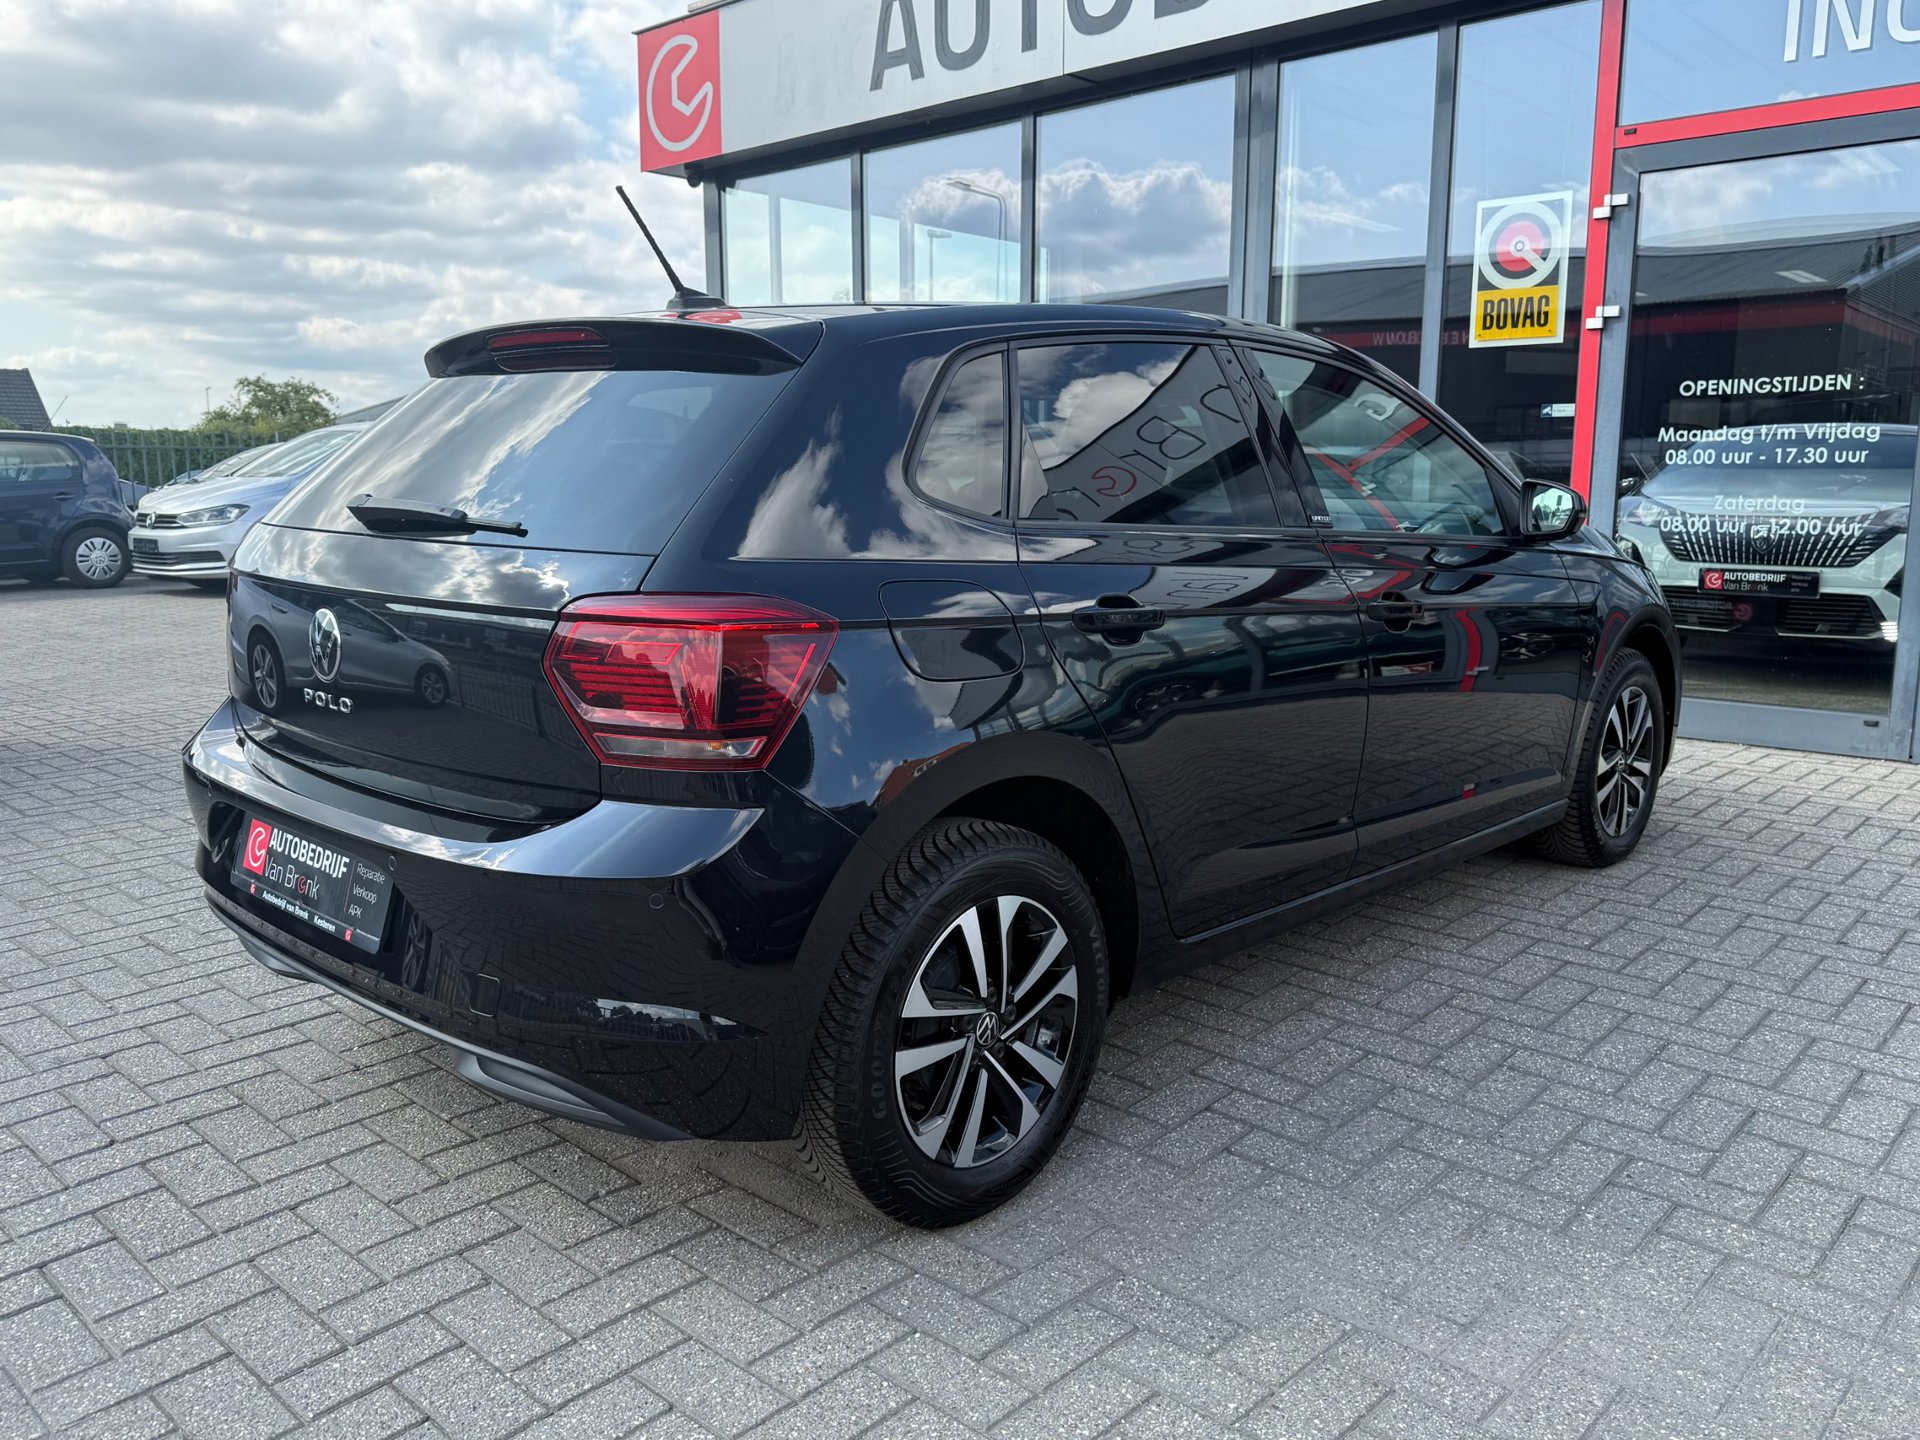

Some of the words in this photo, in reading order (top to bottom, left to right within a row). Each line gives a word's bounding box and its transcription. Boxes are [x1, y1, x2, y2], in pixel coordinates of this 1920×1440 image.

[1482, 295, 1550, 331] BOVAG
[1679, 374, 1852, 397] OPENINGSTIJDEN
[1658, 425, 1754, 445] Maandag
[1760, 425, 1796, 442] t/m
[1804, 422, 1881, 443] Vrijdag
[1665, 449, 1716, 465] 08.00
[1721, 451, 1753, 465] uur
[1774, 447, 1828, 464] 17.30
[1834, 448, 1869, 464] uur
[1713, 495, 1806, 514] Zaterdag
[1660, 516, 1710, 533] 08.00
[1716, 519, 1746, 533] uur
[1769, 517, 1822, 535] 12.00
[1826, 519, 1862, 536] uur
[1723, 571, 1787, 583] AUTOBEDRIJF
[1723, 582, 1740, 591] Van
[304, 687, 354, 714] POLO
[268, 828, 350, 878] AUTOBEDRIJF
[264, 854, 284, 883] Van
[353, 883, 378, 904] Verkoop
[348, 904, 363, 919] APK
